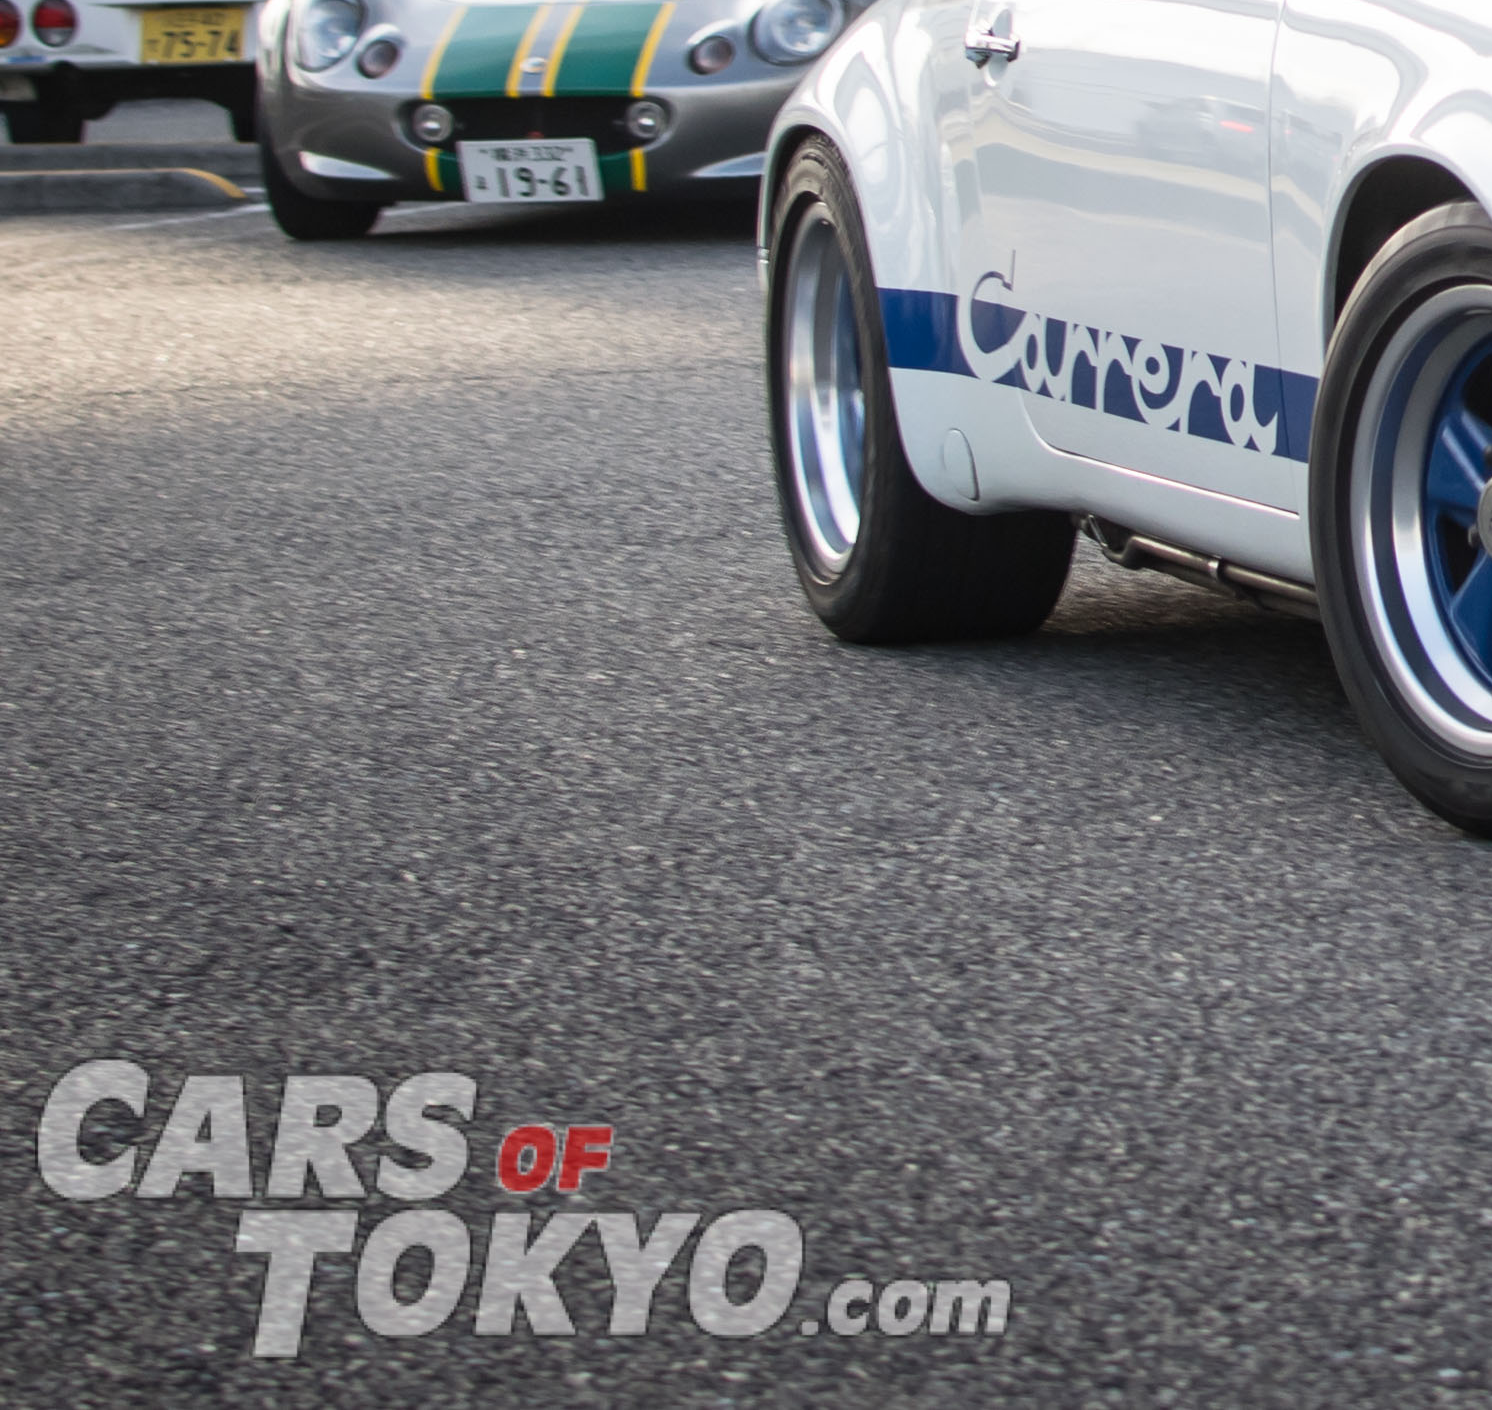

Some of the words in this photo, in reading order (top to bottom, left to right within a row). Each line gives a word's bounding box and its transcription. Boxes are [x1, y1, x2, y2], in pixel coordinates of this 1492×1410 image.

[161, 29, 241, 60] 75-74
[496, 164, 590, 199] 19-61
[956, 249, 1279, 456] Carrera
